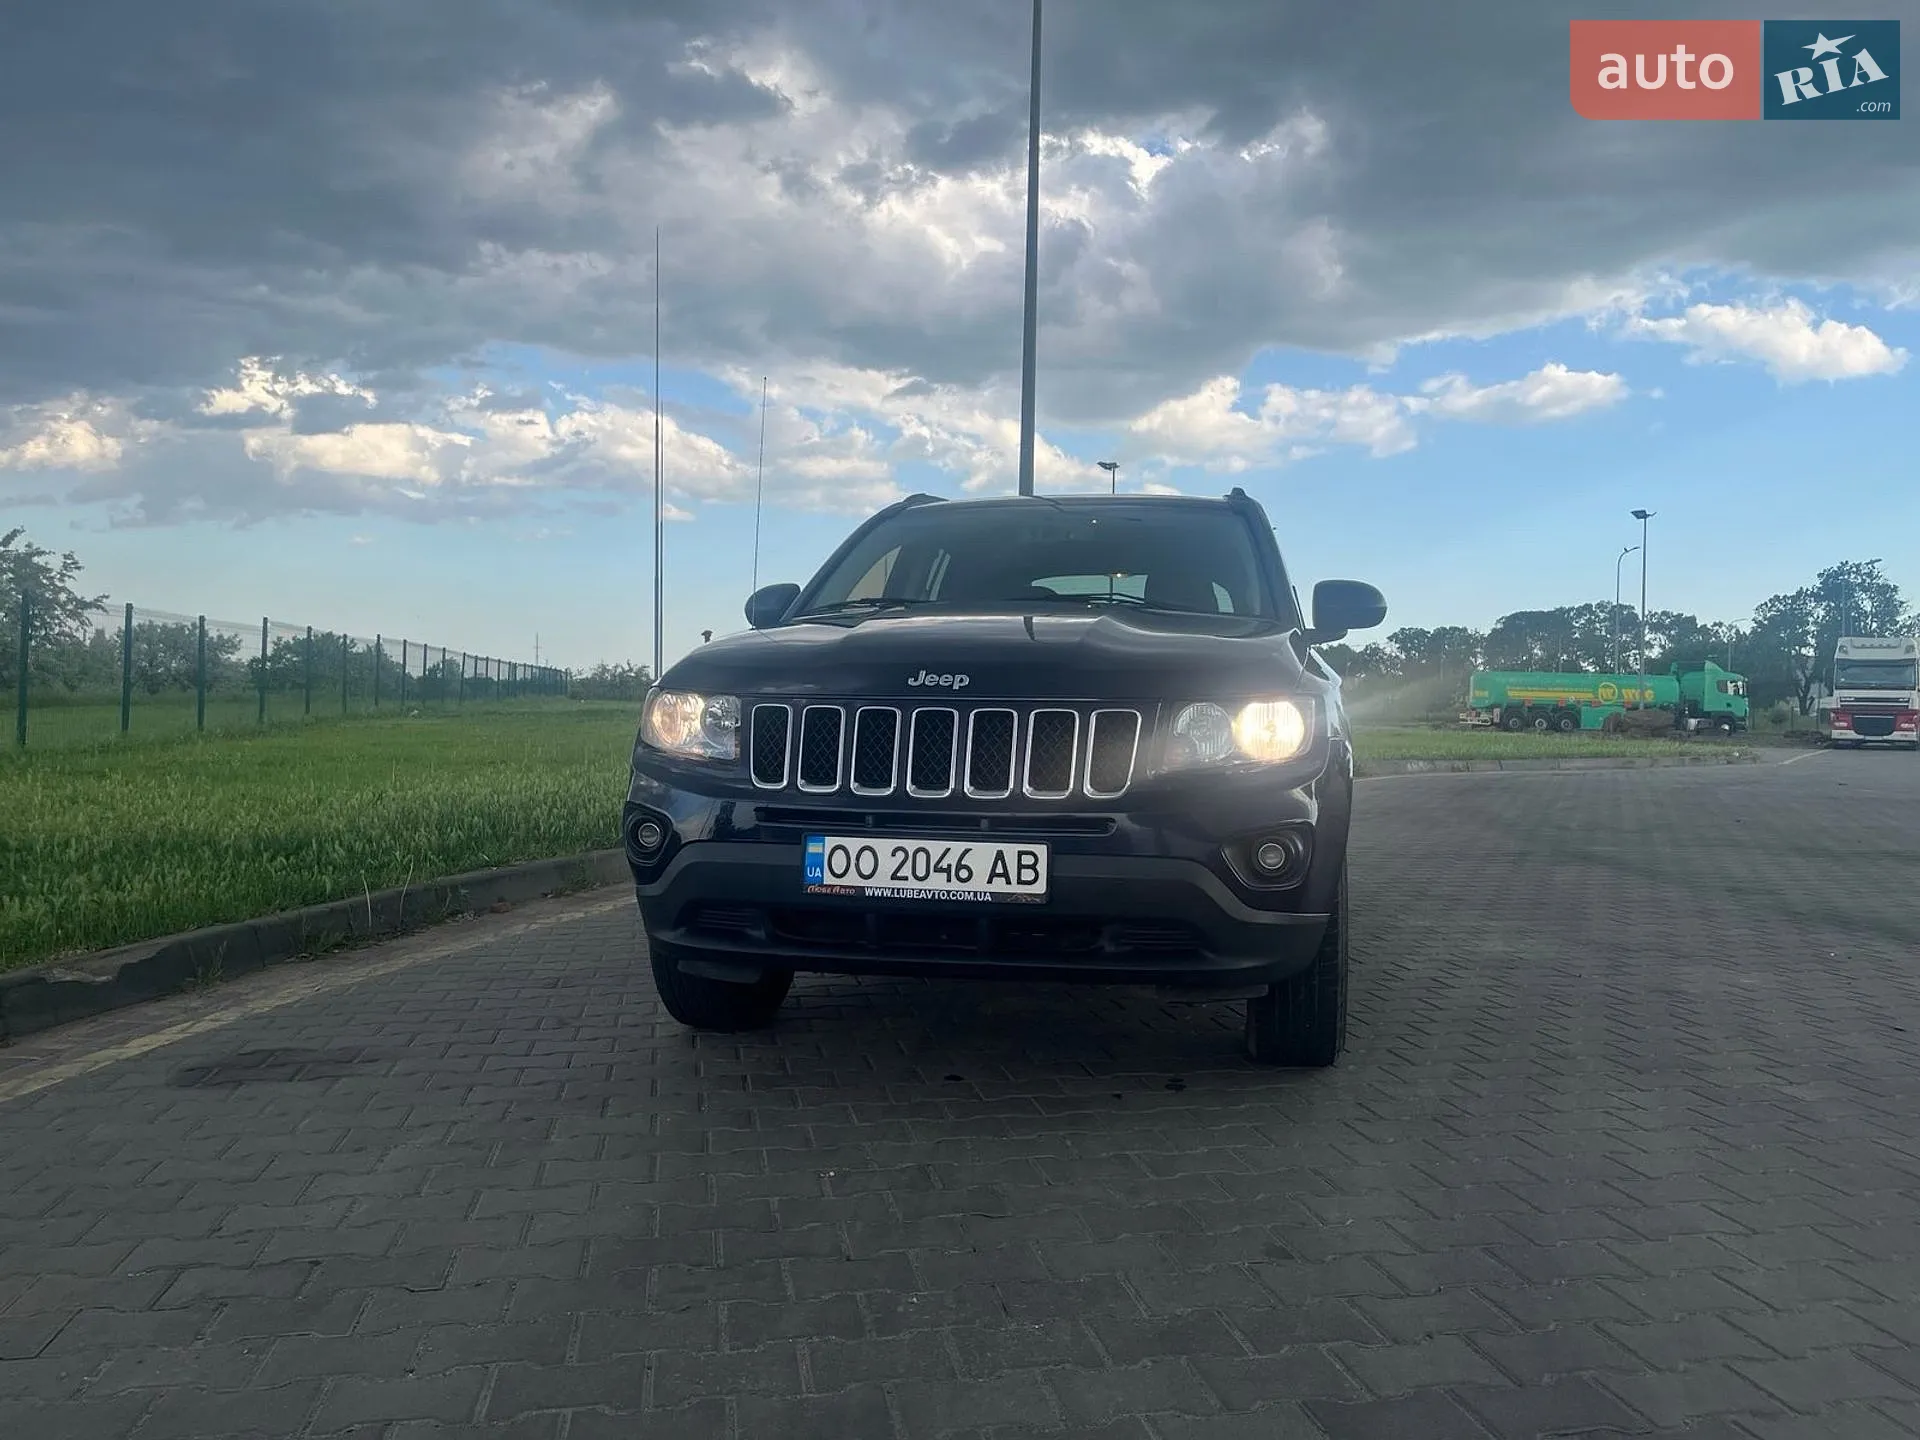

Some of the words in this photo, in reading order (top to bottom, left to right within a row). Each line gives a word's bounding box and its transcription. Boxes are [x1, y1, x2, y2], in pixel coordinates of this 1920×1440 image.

[908, 670, 969, 690] Jeep
[807, 866, 822, 877] UA
[827, 844, 879, 880] OO
[890, 846, 973, 883] 2046
[986, 849, 1040, 885] AB
[865, 887, 992, 901] WWW.LUBEAVTO.COM.UA
